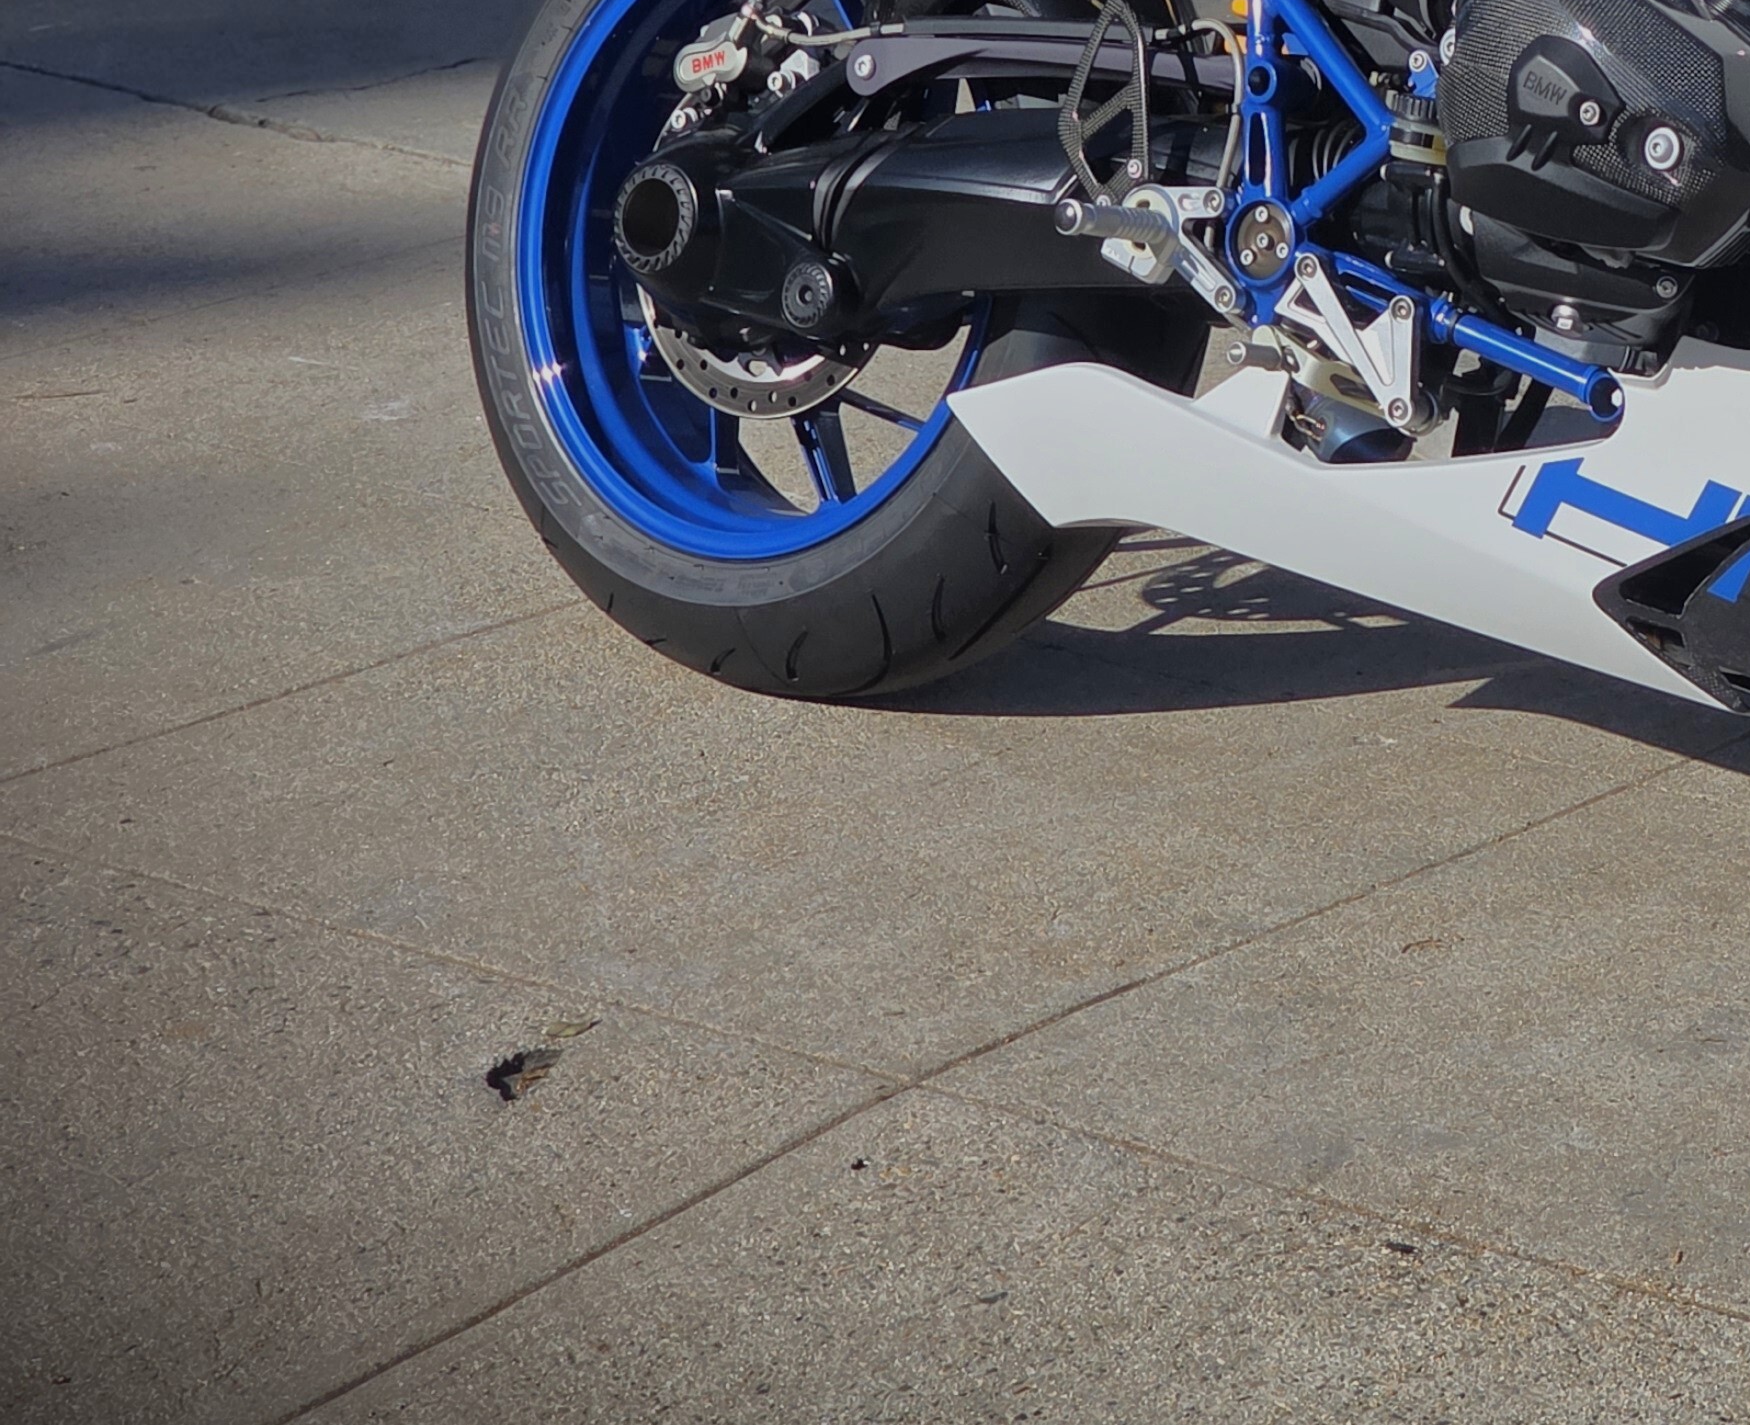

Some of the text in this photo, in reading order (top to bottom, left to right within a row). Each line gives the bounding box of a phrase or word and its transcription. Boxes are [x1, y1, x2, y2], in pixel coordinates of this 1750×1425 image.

[692, 50, 725, 74] BMW
[1523, 70, 1567, 106] BMW
[496, 87, 528, 170] RR
[481, 280, 582, 507] SPORTEC
